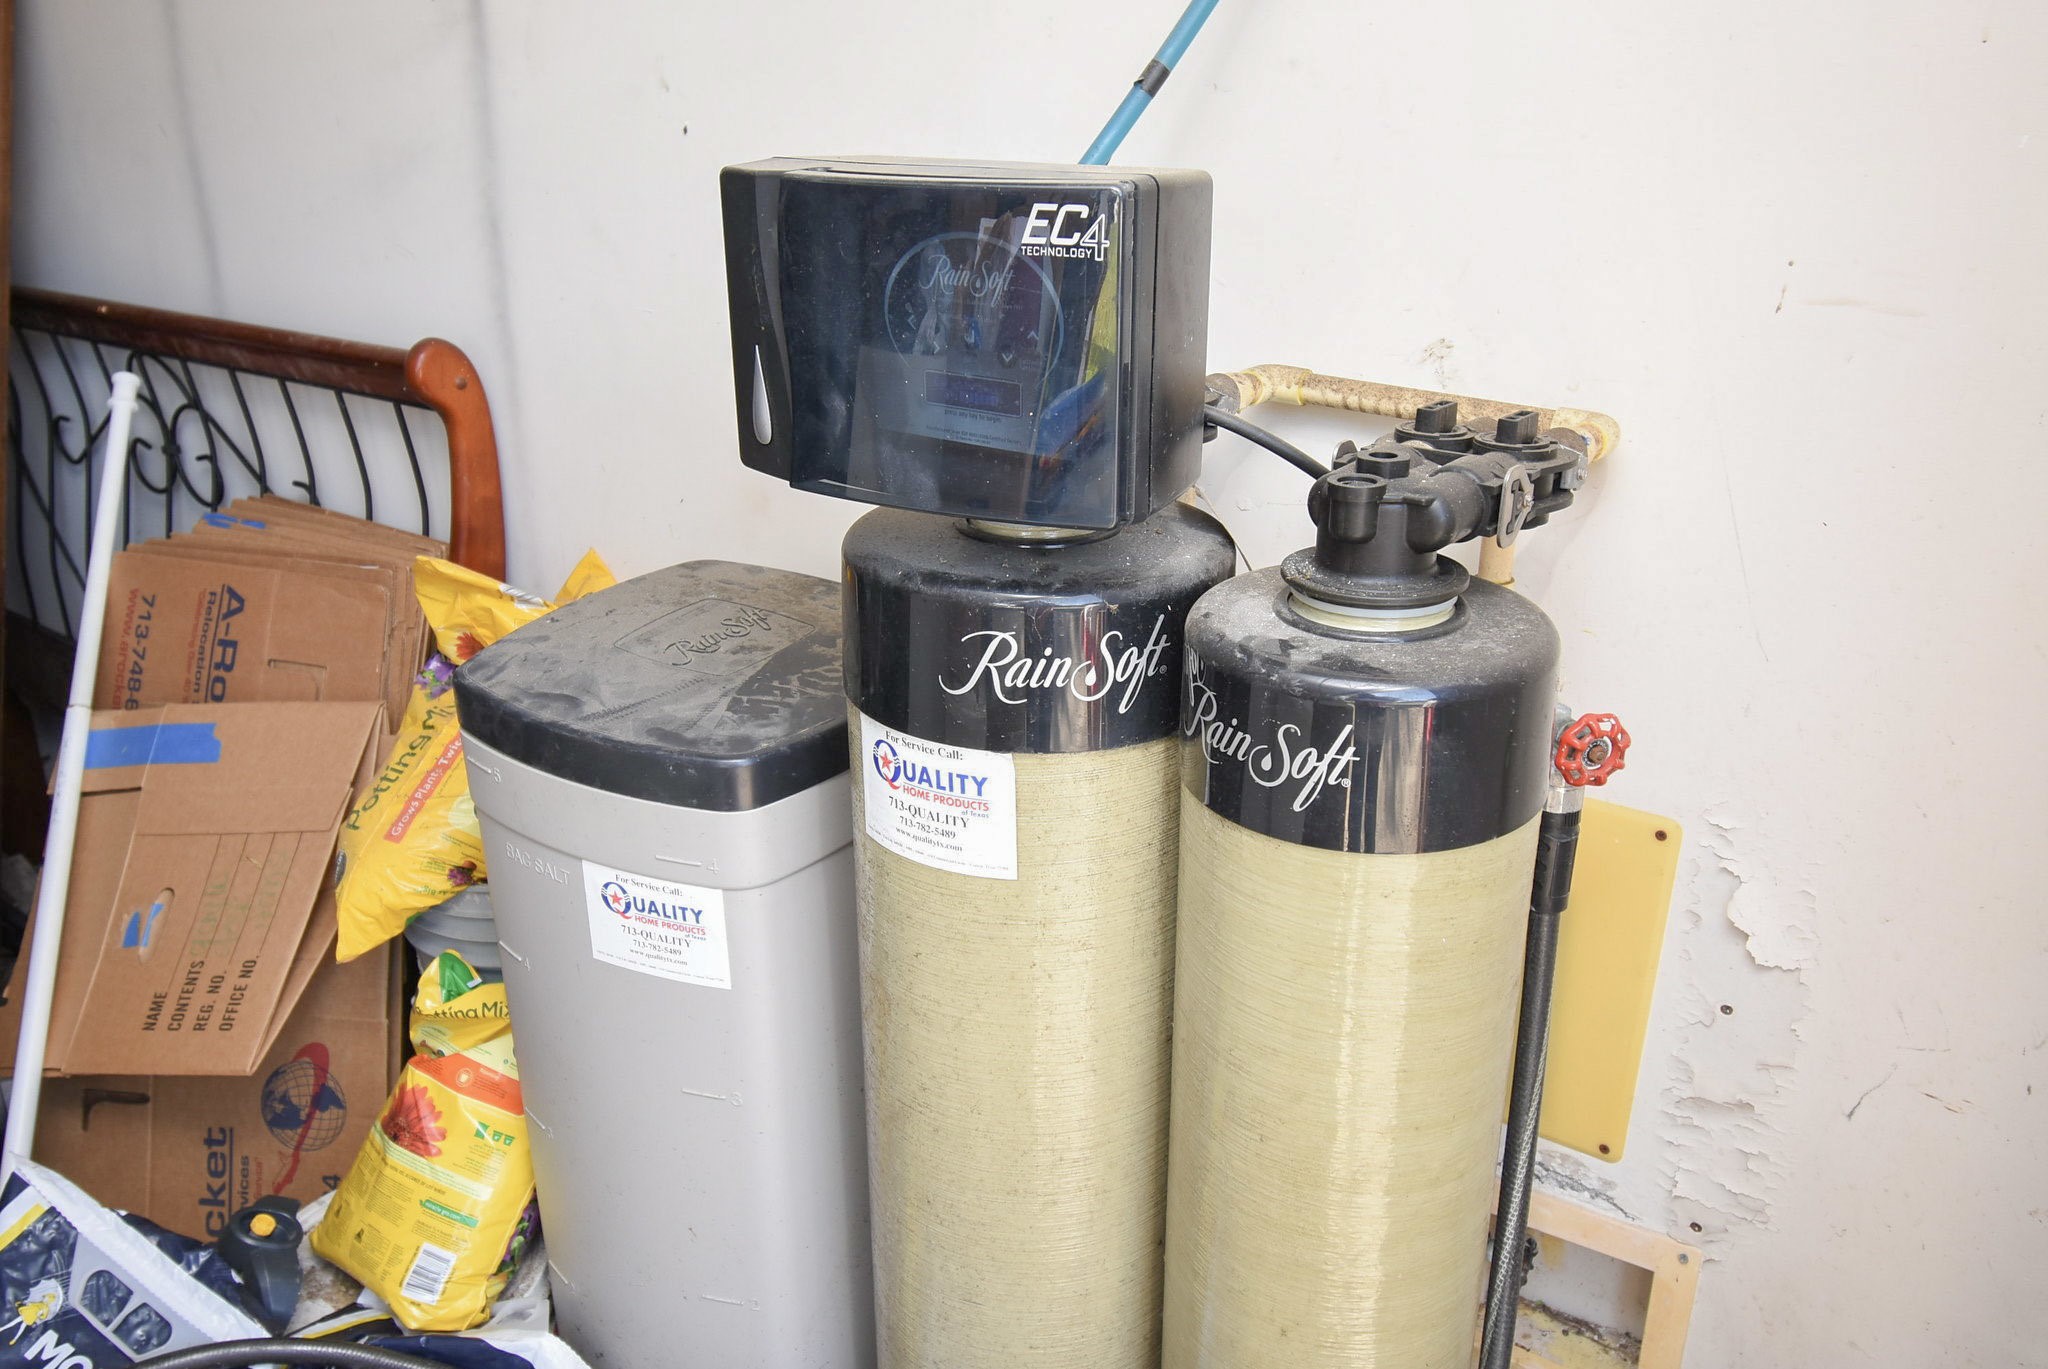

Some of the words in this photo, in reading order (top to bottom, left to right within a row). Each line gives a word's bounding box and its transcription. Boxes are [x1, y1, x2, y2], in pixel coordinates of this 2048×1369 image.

[1021, 203, 1110, 261] EC4
[1021, 246, 1092, 258] TECHNOLOGY
[193, 591, 218, 693] Relocation
[885, 730, 900, 744] For
[902, 737, 935, 755] Service
[938, 747, 963, 761] Call:
[346, 734, 431, 831] Potting
[873, 739, 989, 797] QUALITY
[391, 799, 419, 837] Grows
[438, 738, 463, 766] Twic
[902, 784, 930, 801] HOME
[933, 793, 989, 811] PRODUCTS
[888, 795, 970, 828] 713-QUALITY
[899, 815, 956, 839] 713-782-5489
[970, 810, 989, 819] Texas
[896, 827, 963, 852] www.qualitytx.com
[505, 842, 531, 867] BAG
[534, 857, 570, 884] SALT
[601, 881, 703, 924] QUALITY
[615, 873, 629, 884] For
[631, 878, 660, 893] Service
[662, 885, 683, 897] Call:
[621, 925, 692, 949] 713-QUALITY
[635, 914, 659, 928] HOME
[661, 921, 706, 936] PRODUCTS
[633, 939, 682, 956] 713-782-5489
[142, 991, 168, 1031] NAME
[167, 960, 205, 1031] CONTENTS
[193, 1000, 216, 1031] REG.
[207, 970, 228, 994] NO.
[219, 984, 248, 1031] OFFICE
[238, 955, 261, 979] NO.
